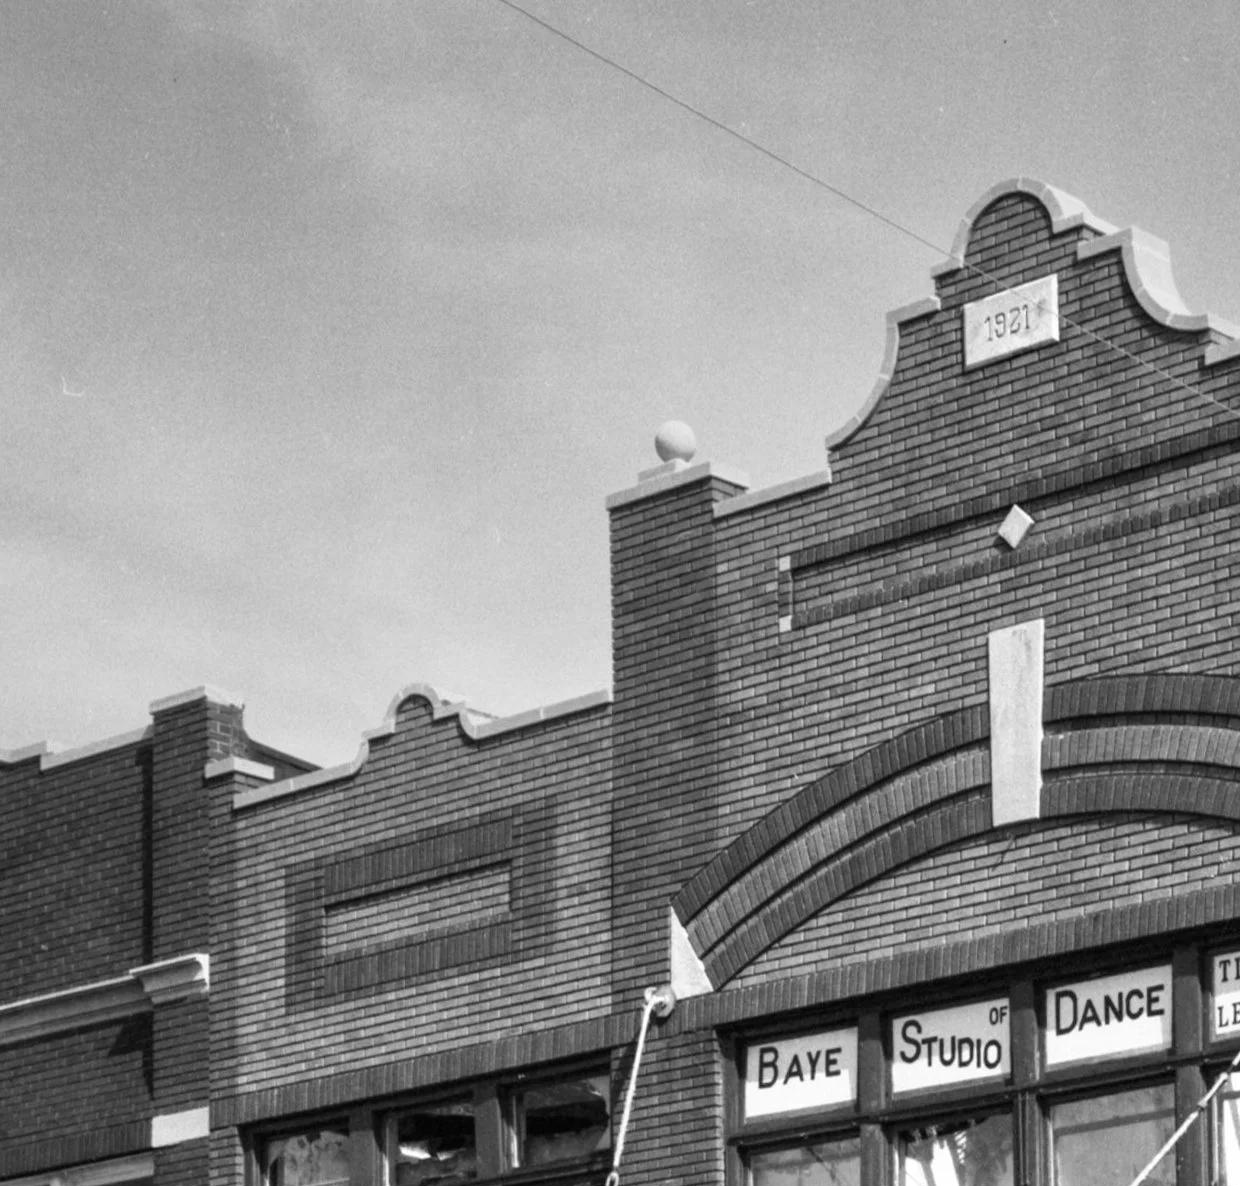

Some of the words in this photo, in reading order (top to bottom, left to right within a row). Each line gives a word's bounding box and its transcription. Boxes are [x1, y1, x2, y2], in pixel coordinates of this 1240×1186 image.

[984, 304, 1029, 341] 1921
[989, 1006, 1008, 1024] OF
[1055, 984, 1166, 1036] DANCE
[900, 1020, 1001, 1069] STUDIO
[757, 1047, 842, 1090] BAYE
